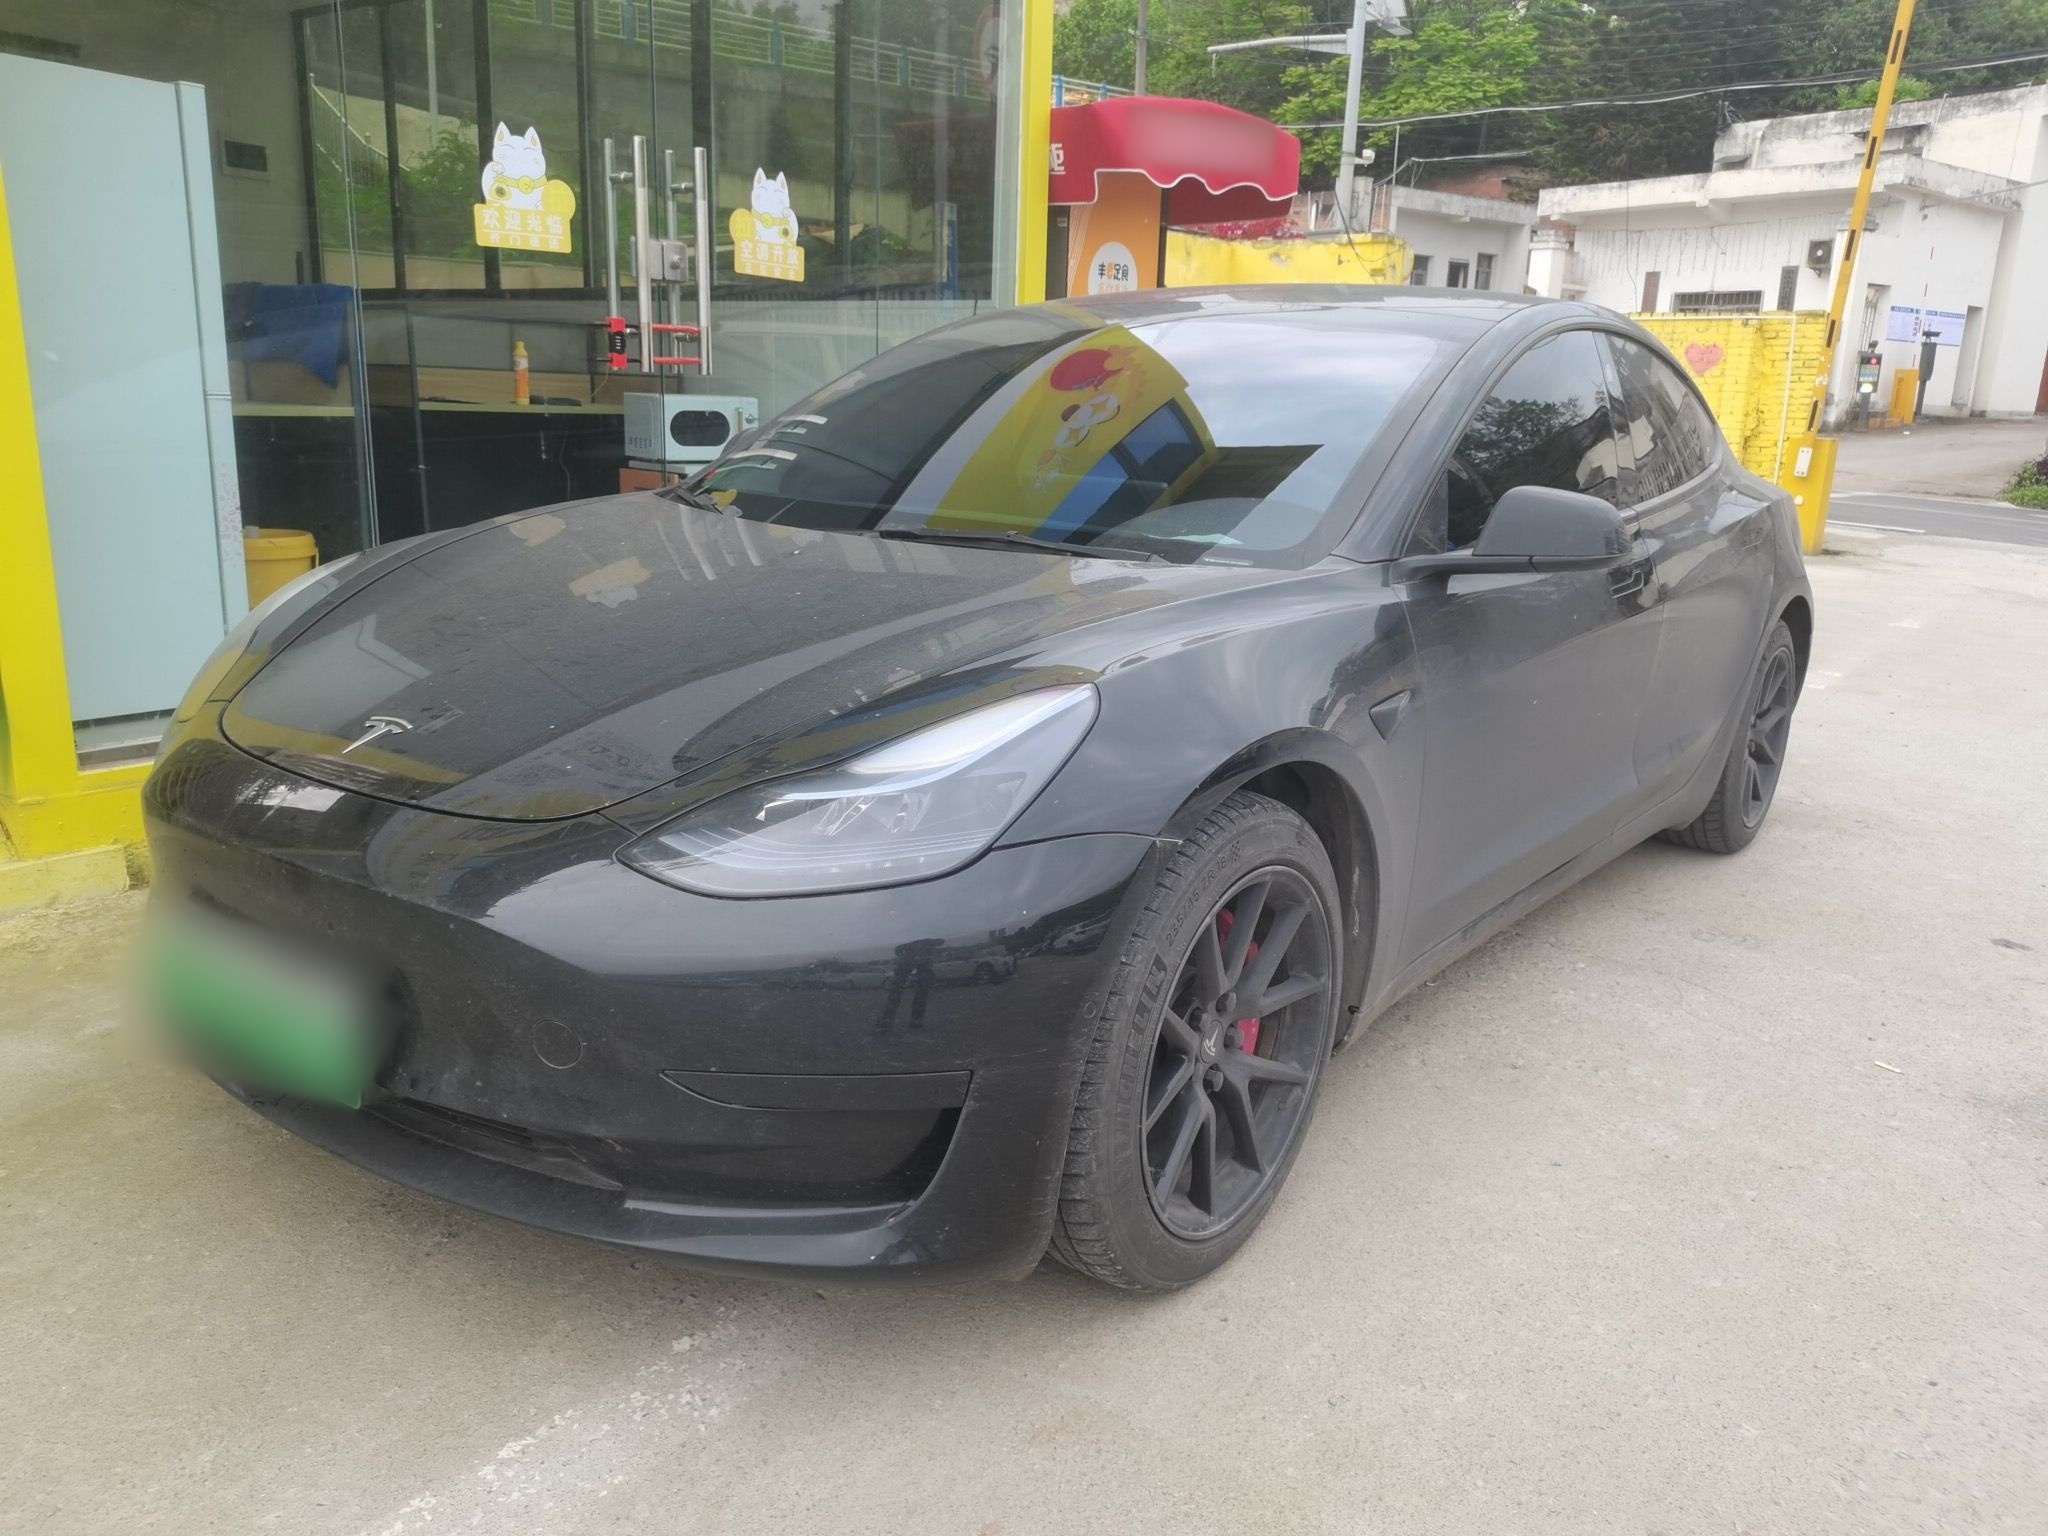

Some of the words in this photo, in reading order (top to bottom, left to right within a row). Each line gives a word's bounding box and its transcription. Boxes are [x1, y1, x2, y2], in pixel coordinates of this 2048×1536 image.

[482, 208, 563, 234] 欢迎光临
[741, 239, 799, 267] 空调开放
[1217, 855, 1227, 871] 18
